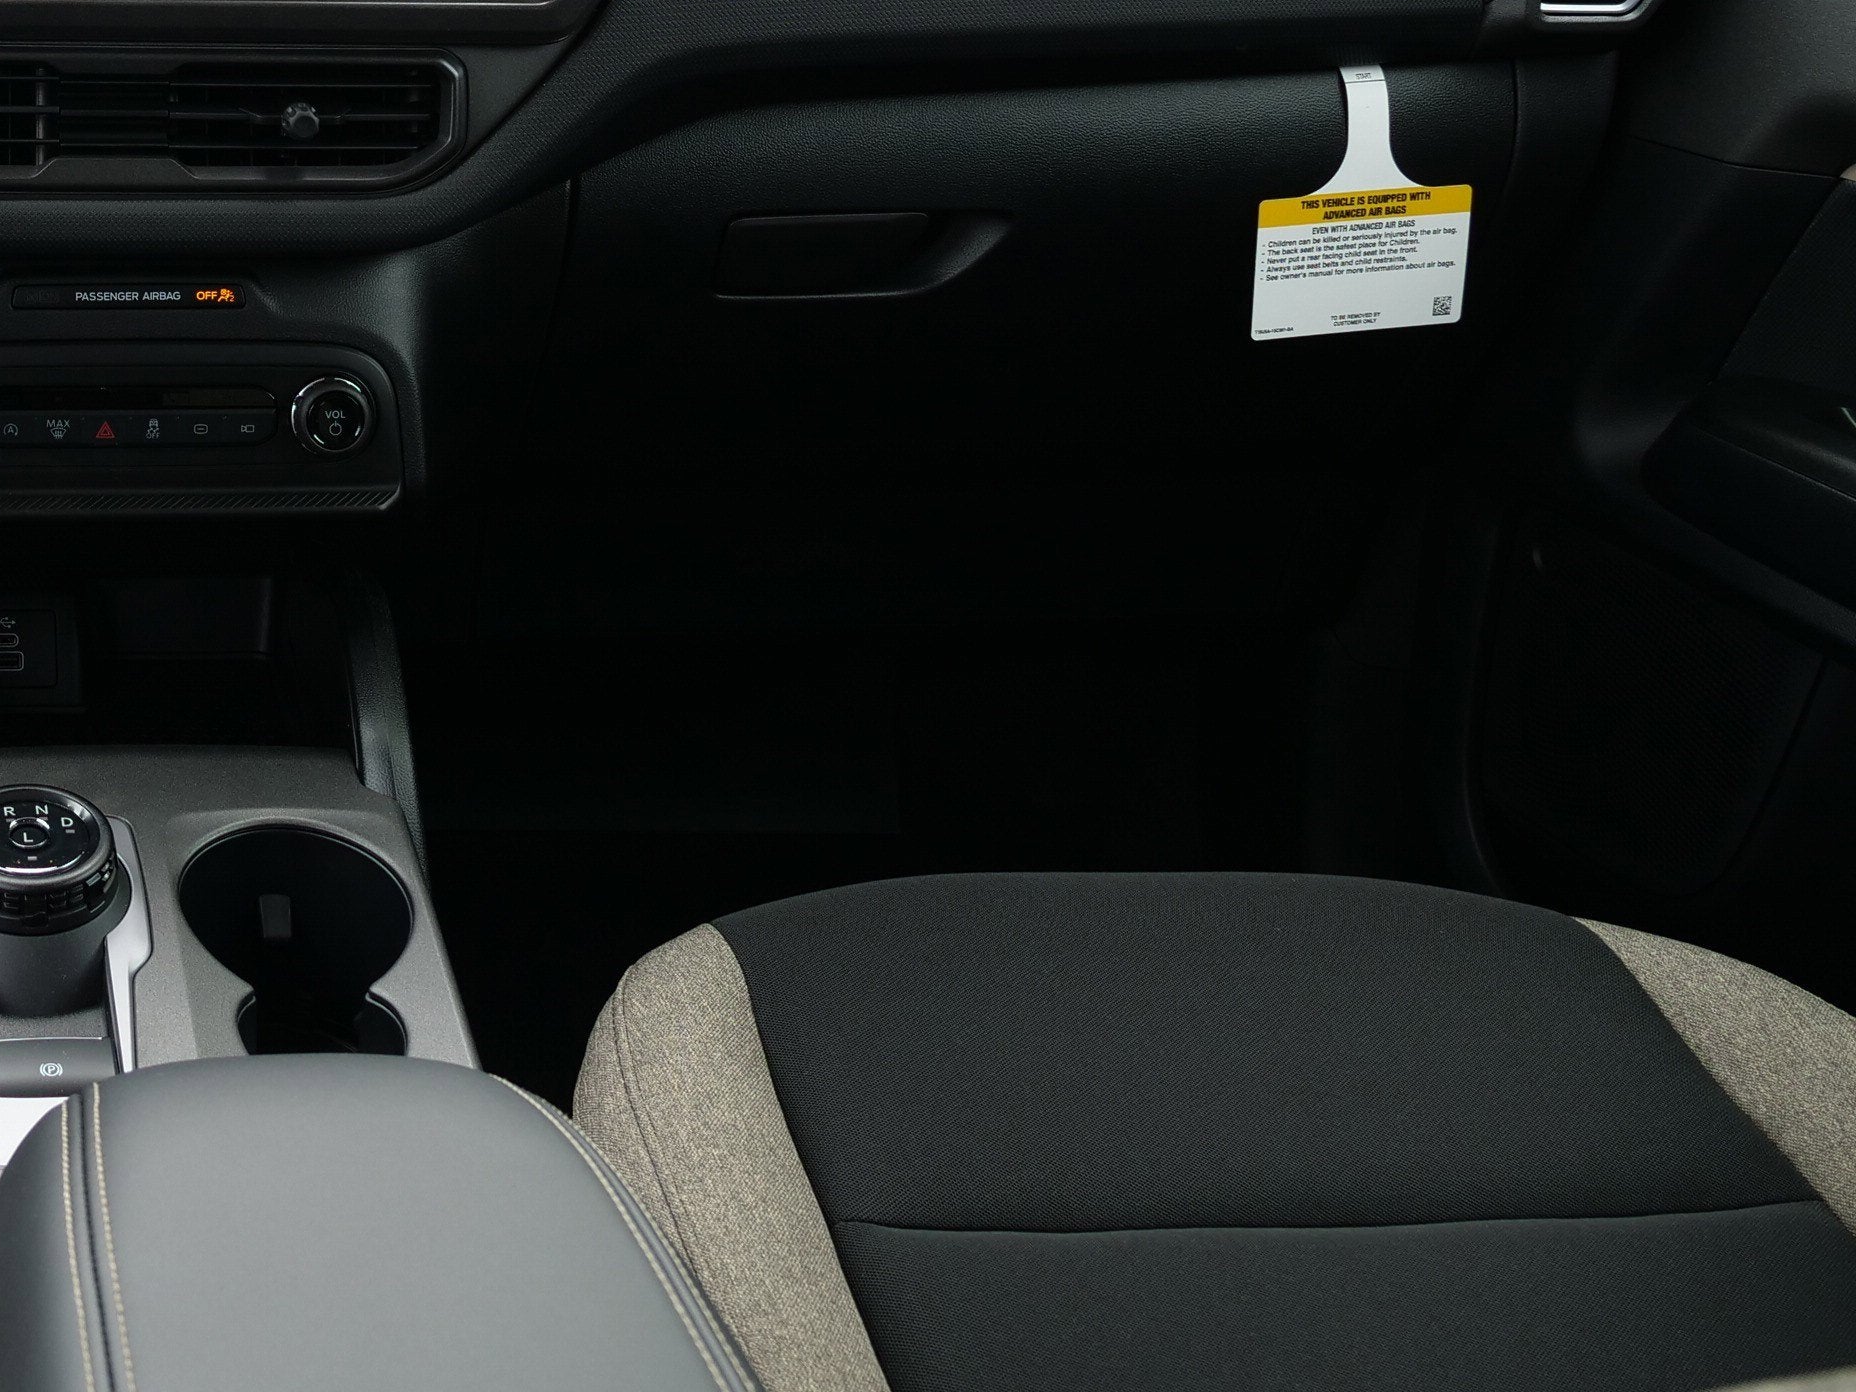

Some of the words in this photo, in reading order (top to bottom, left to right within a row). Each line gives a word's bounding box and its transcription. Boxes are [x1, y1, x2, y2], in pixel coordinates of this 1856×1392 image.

[1301, 200, 1320, 210] THIS
[1320, 197, 1355, 208] VEHICLE
[1357, 196, 1365, 205] IS
[1367, 193, 1407, 204] EQUIPPED
[1409, 191, 1431, 201] WITH
[1323, 208, 1367, 220] ADVANCED
[1368, 207, 1383, 216] AIR
[1385, 205, 1407, 215] BAGS
[1312, 227, 1329, 235] EVEN
[1330, 225, 1348, 233] WITH
[1349, 222, 1384, 232] ADVANCED
[1385, 221, 1396, 229] AIR
[1398, 219, 1416, 228] BAGS
[1268, 240, 1297, 248] Children
[1322, 234, 1341, 243] killed
[1351, 232, 1383, 242] seriously
[1384, 230, 1408, 239] injured
[1409, 229, 1418, 237] by
[1419, 228, 1432, 236] the
[1432, 227, 1442, 235] air
[1443, 227, 1458, 235] bag.
[1267, 249, 1281, 257] The
[1282, 247, 1298, 256] back
[1299, 246, 1315, 254] seat
[1323, 244, 1335, 252] the
[1335, 242, 1357, 251] safest
[1358, 241, 1376, 249] place
[1389, 238, 1420, 247] Children.
[1267, 257, 1287, 265] Never
[1288, 256, 1300, 264] put
[1307, 254, 1321, 262] rear
[1322, 252, 1343, 261] facing
[1344, 250, 1362, 258] child
[1387, 247, 1398, 255] the
[1399, 246, 1418, 254] front.
[1266, 265, 1291, 273] Always
[1355, 258, 1372, 266] child
[1373, 256, 1407, 264] restraints.
[1266, 274, 1279, 282] See
[1280, 272, 1307, 280] owner's
[1308, 269, 1333, 278] manual
[1345, 267, 1364, 275] more
[1364, 263, 1404, 273] information
[1405, 262, 1425, 270] about
[1437, 260, 1456, 268] bags.
[75, 291, 139, 302] PASSENGER
[142, 291, 181, 301] AIRBAG
[196, 291, 218, 301] OFF
[325, 410, 346, 420] VOL
[46, 419, 71, 429] MAX
[3, 806, 16, 816] R
[35, 804, 49, 815] N
[61, 817, 74, 827] D
[22, 832, 34, 843] L
